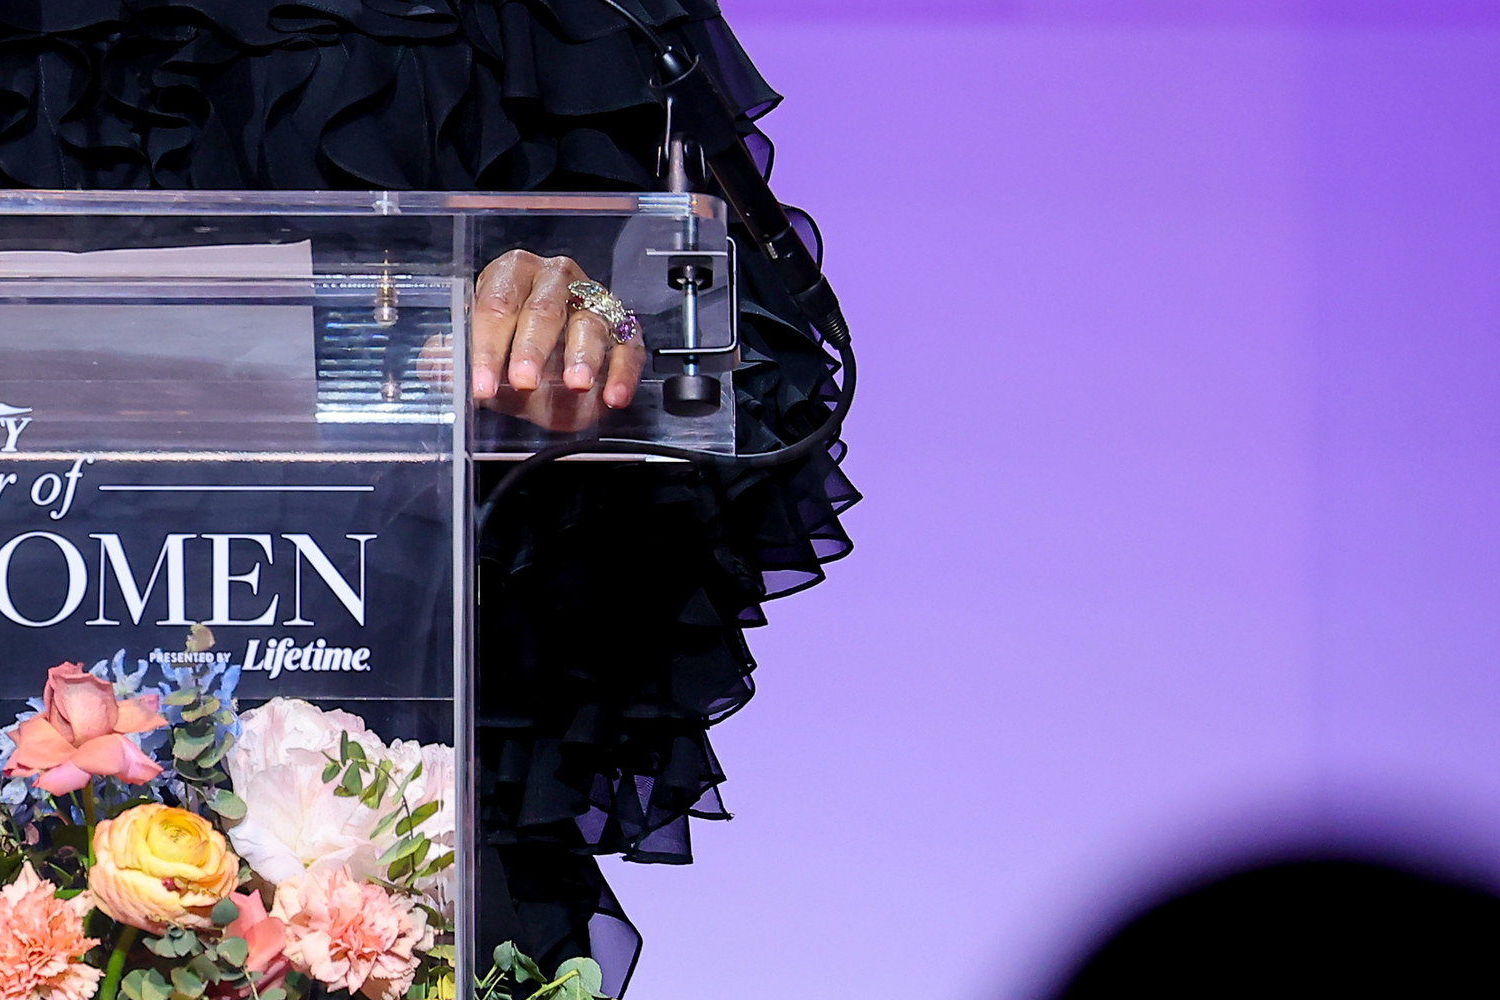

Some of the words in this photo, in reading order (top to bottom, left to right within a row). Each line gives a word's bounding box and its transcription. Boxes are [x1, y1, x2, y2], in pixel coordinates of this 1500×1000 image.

[30, 456, 94, 520] of
[149, 652, 214, 663] PRESENTED
[217, 651, 231, 663] BY
